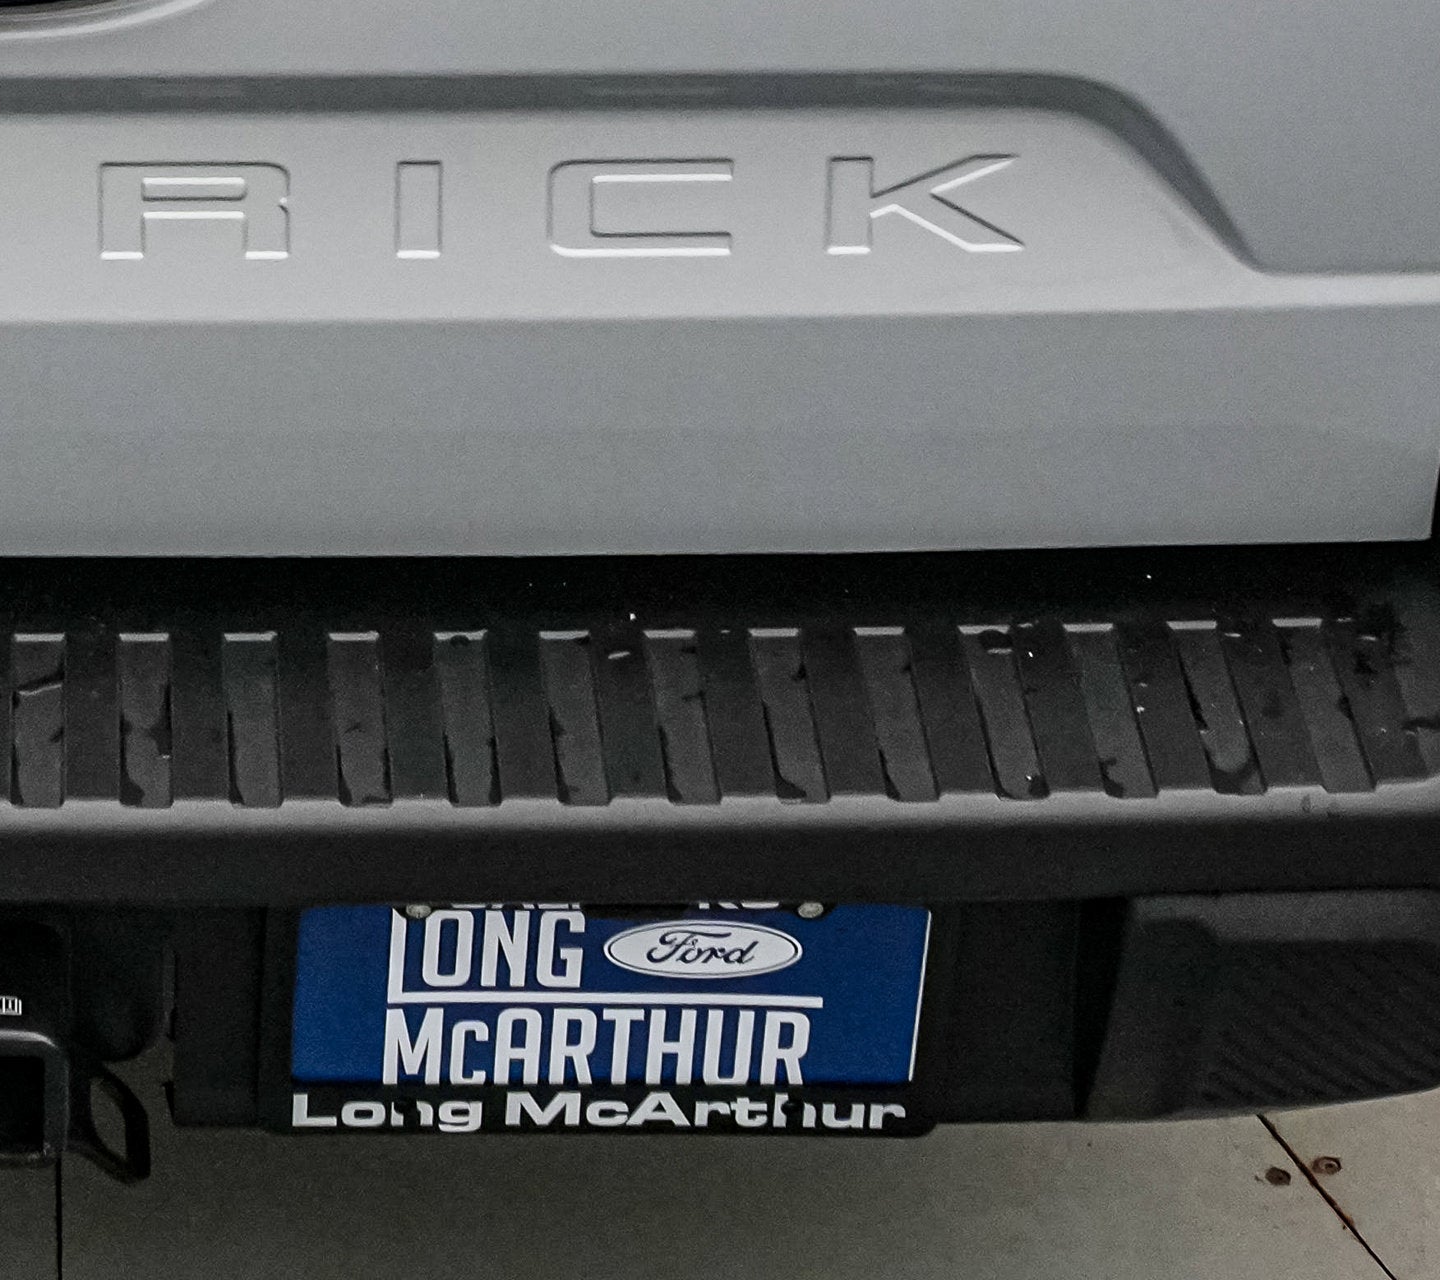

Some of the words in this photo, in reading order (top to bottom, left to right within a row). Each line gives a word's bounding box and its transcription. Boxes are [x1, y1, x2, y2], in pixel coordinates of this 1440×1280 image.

[386, 908, 586, 1004] LONG
[646, 930, 759, 965] Ford
[381, 1009, 812, 1086] McARTHUR
